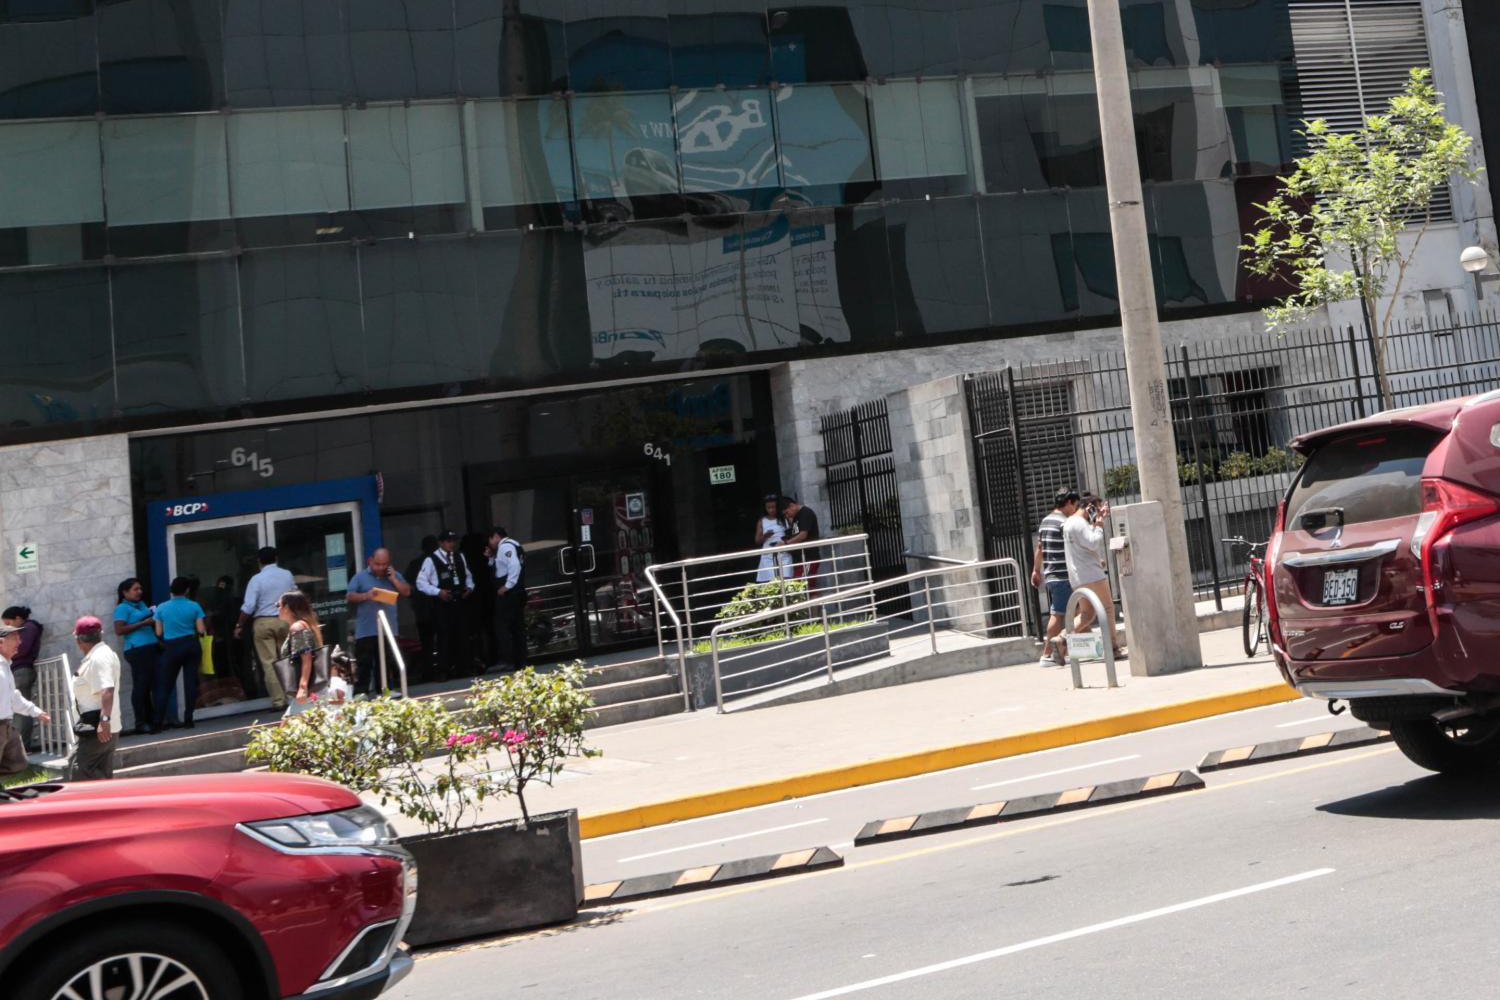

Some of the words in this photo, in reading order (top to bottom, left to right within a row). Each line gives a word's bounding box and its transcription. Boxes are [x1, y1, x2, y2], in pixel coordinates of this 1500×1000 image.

[231, 447, 274, 478] 615
[643, 442, 671, 466] 641
[713, 471, 732, 480] 180
[173, 504, 202, 517] BCP
[1323, 577, 1357, 599] BED-150
